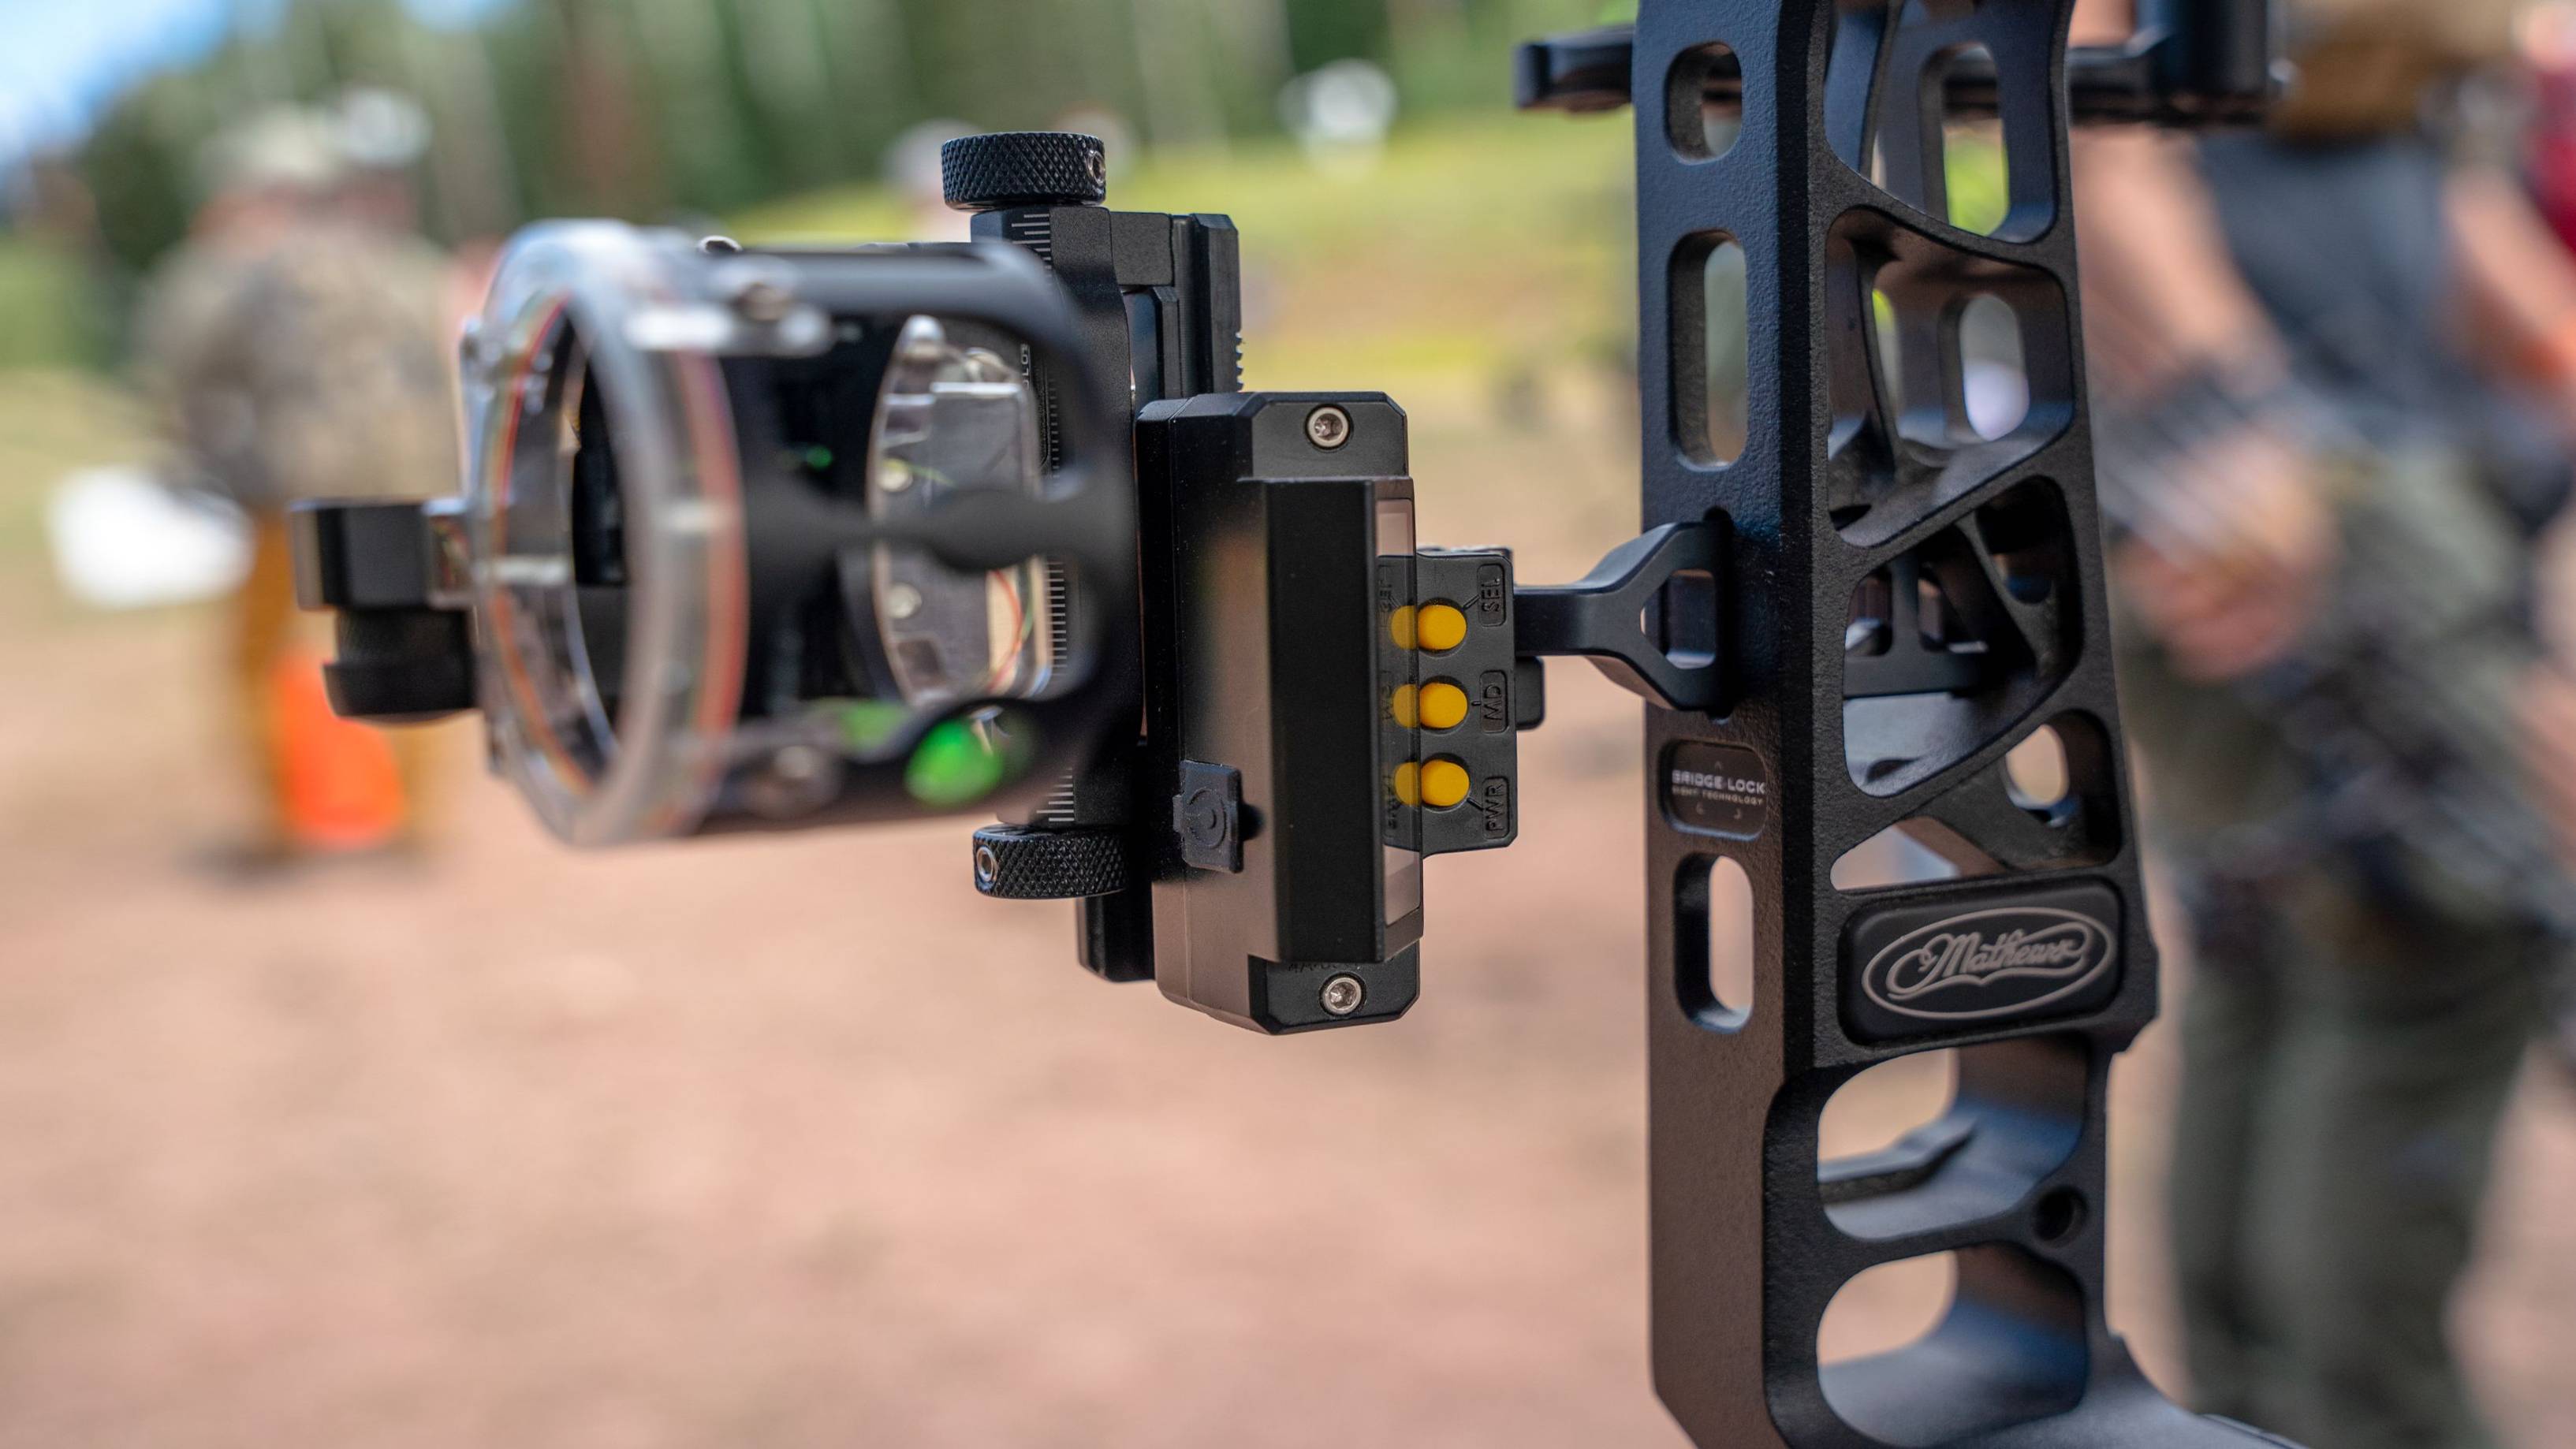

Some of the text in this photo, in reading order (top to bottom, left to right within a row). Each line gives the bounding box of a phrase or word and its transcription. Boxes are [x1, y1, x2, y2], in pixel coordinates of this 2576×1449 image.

[1481, 578, 1501, 612] SEL
[1484, 684, 1502, 720] MD
[1672, 769, 1765, 795] BRIDGE LOCK
[1702, 790, 1763, 806] TECHNOLOGY
[1485, 784, 1504, 831] PWR
[1886, 922, 2092, 996] Mathews
